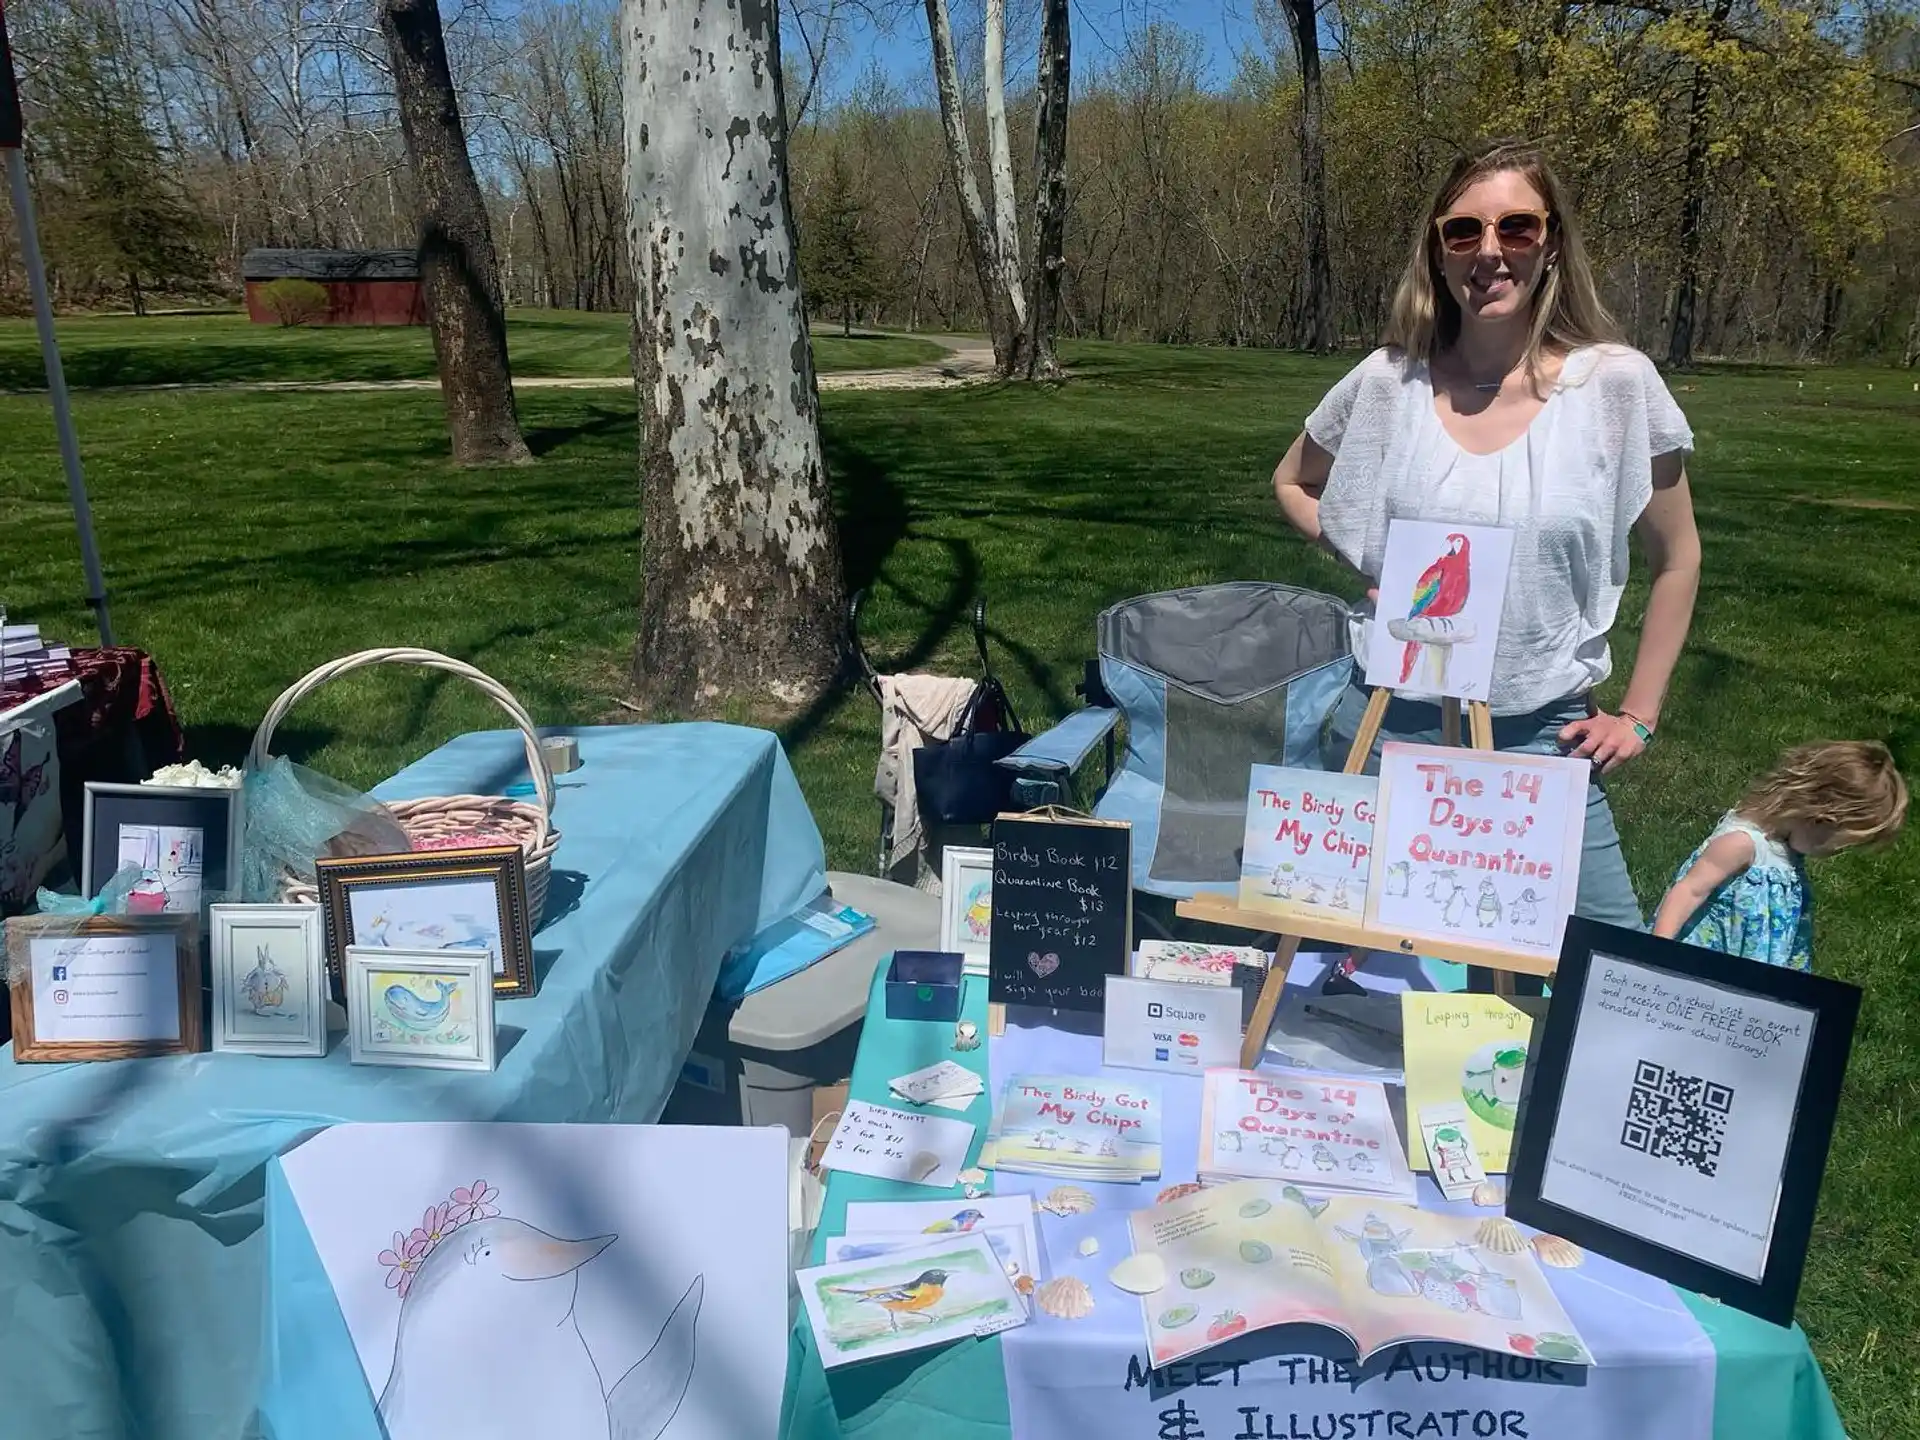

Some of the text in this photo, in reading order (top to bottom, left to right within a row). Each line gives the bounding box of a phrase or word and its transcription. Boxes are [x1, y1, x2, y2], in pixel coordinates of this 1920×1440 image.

[1416, 764, 1543, 804] The 14
[1256, 789, 1376, 825] The Birdy Go
[1429, 797, 1534, 838] Days of
[1275, 819, 1313, 855] My
[996, 842, 1040, 867] Birdy
[1047, 849, 1086, 867] Book
[1409, 834, 1553, 880] Quarantine
[1067, 878, 1101, 897] Book
[1039, 926, 1070, 940] year
[1073, 934, 1096, 946] $12
[1004, 970, 1023, 980] will
[1045, 987, 1070, 1005] your
[1080, 986, 1103, 997] boo
[1604, 969, 1801, 1037] Book me for a school visit or event
[1165, 1007, 1207, 1022] Square
[1601, 987, 1784, 1046] and receive ONE FREE BOOK
[1152, 1033, 1174, 1043] VISA
[1598, 1000, 1768, 1059] donated to your school library!
[1018, 1086, 1149, 1110] The Birdy Got
[1239, 1078, 1357, 1107] The 14
[1037, 1102, 1142, 1135] My Chips
[1255, 1097, 1355, 1125] Days of
[842, 1125, 851, 1133] 2
[860, 1130, 875, 1139] for
[1238, 1115, 1380, 1150] Quarantine
[853, 1144, 872, 1155] for
[885, 1148, 903, 1159] $15
[1125, 1344, 1564, 1391] MEET THE AUTHOR
[1235, 1407, 1528, 1440] ILLUSTRATOR
